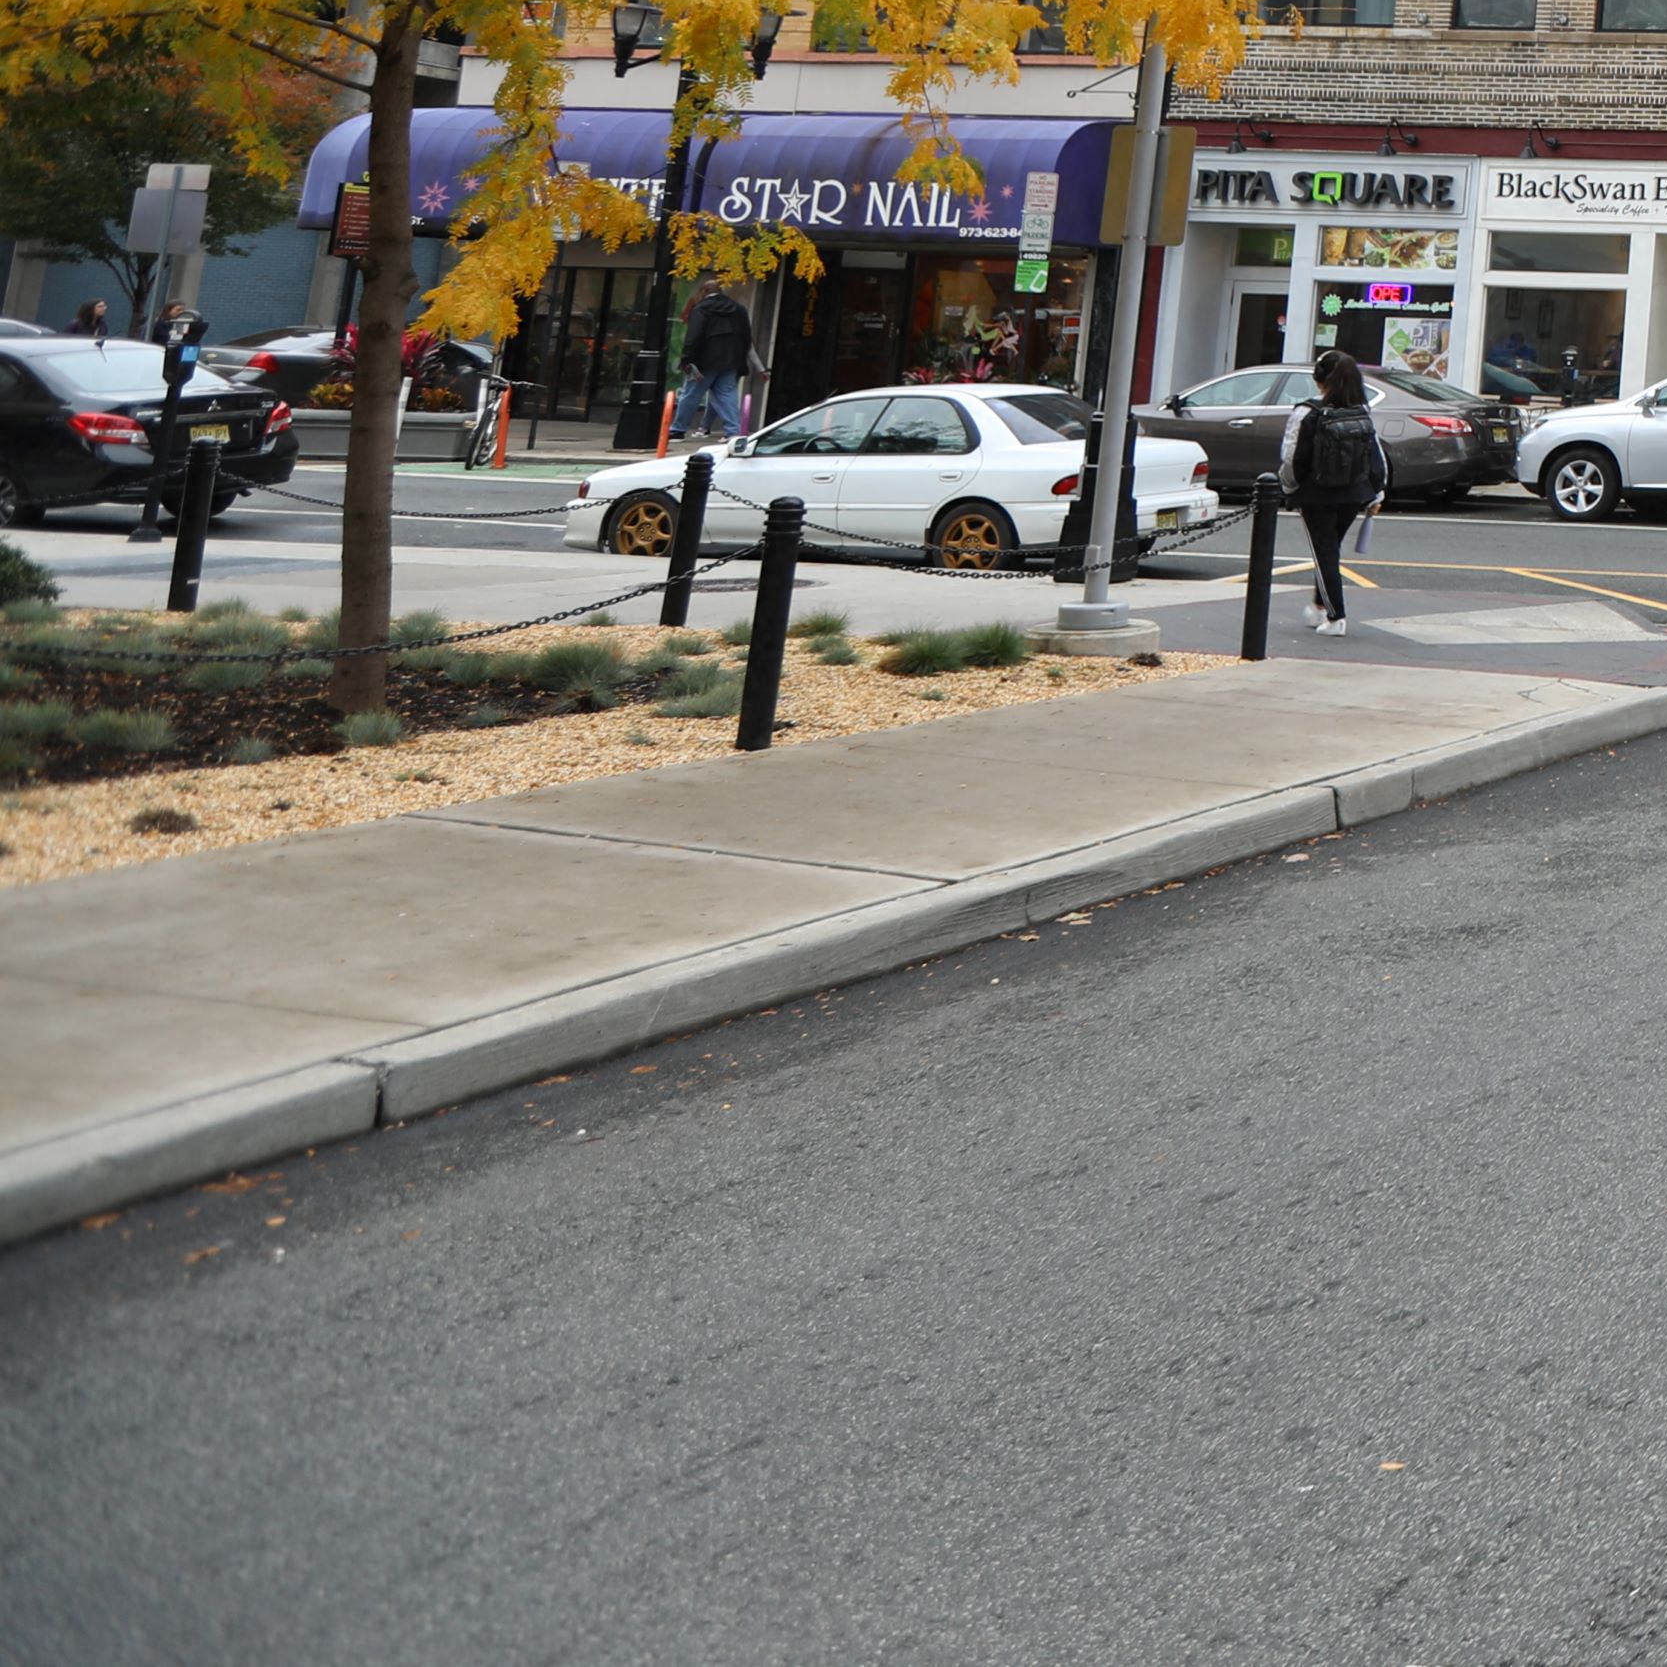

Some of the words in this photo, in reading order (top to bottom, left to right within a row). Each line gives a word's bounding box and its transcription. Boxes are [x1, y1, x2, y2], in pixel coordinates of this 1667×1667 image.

[864, 181, 960, 228] NAIL
[1194, 169, 1280, 204] PITA
[1290, 171, 1456, 207] SQUARE
[1495, 172, 1647, 204] BlackSwan
